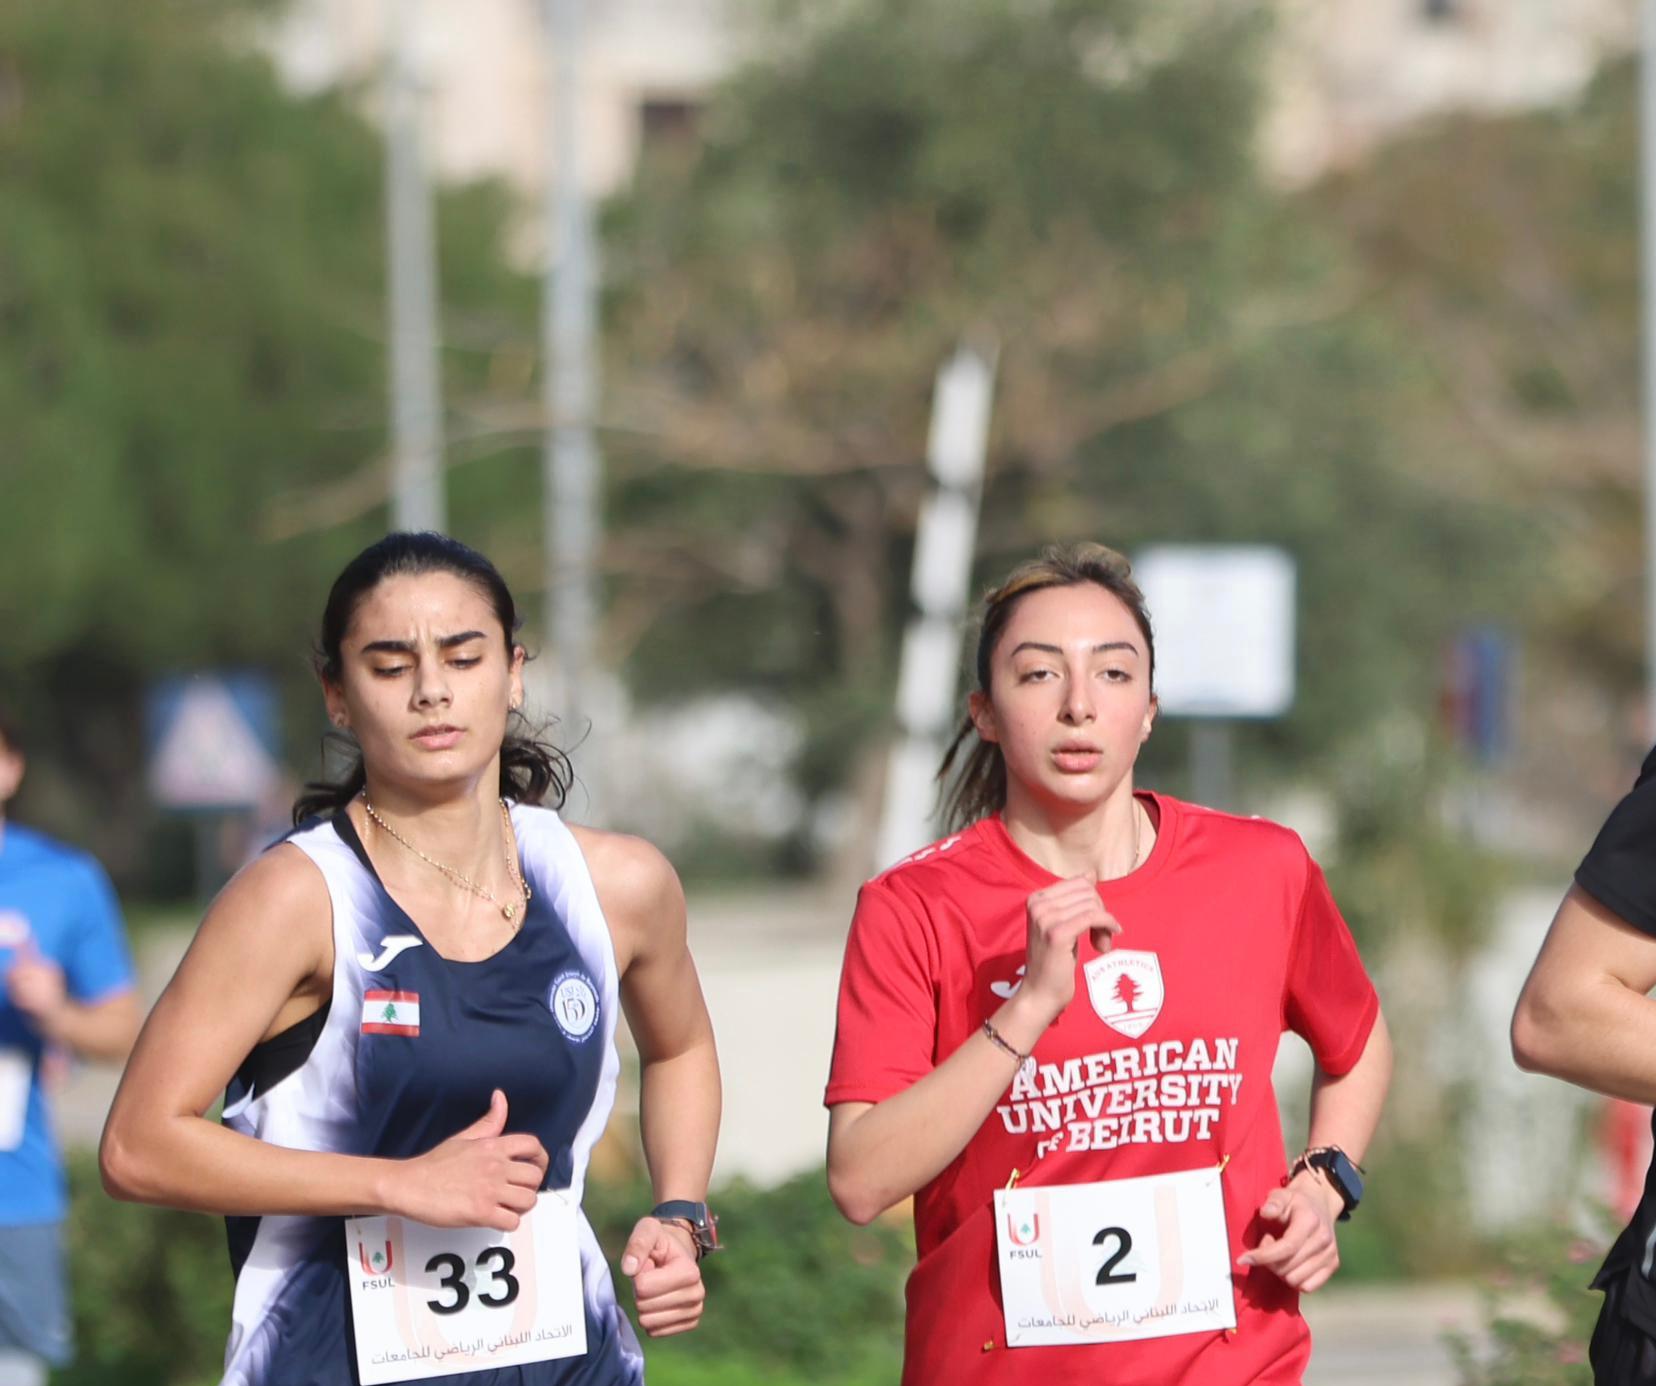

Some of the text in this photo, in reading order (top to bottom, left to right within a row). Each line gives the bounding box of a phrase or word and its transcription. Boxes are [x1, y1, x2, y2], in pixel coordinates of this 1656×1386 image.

[1009, 1038, 1239, 1101] AMERICAN
[996, 1073, 1243, 1134] UNIVERSITY
[1065, 1108, 1220, 1152] BEIRUT
[361, 1277, 396, 1291] FSUL
[423, 1246, 520, 1315] 33
[1009, 1249, 1043, 1260] FSUL
[1092, 1226, 1137, 1286] 2
